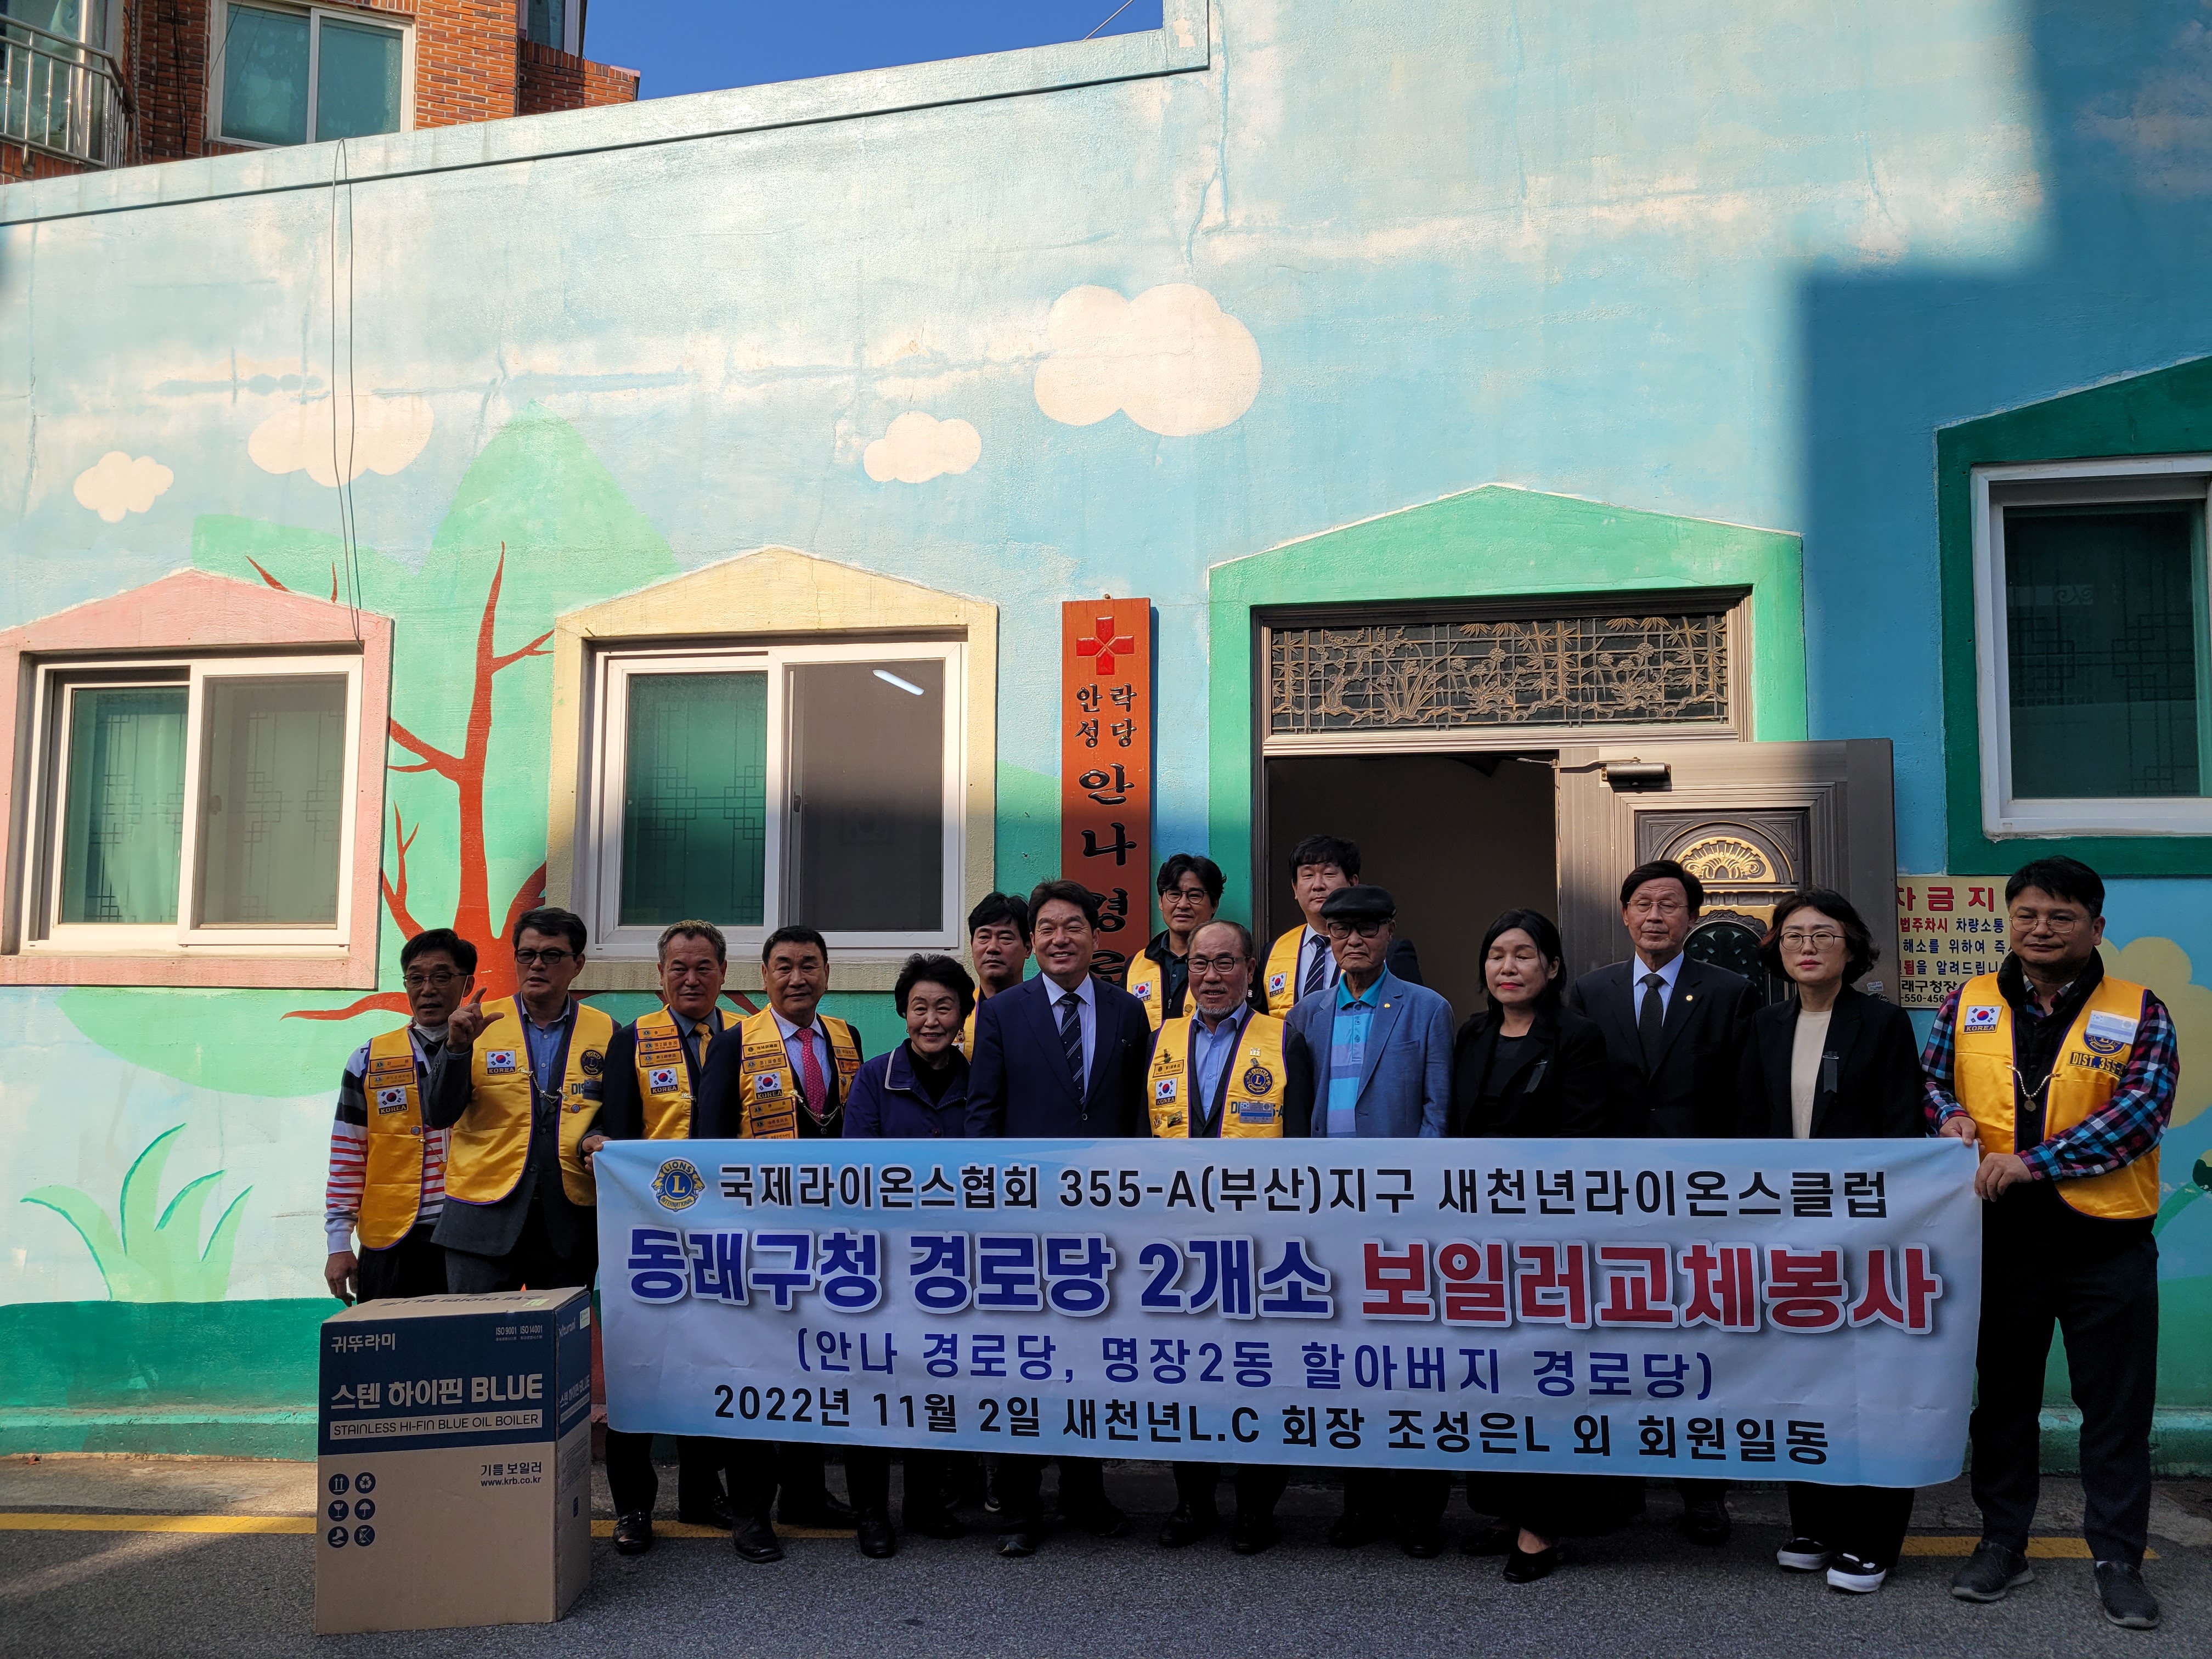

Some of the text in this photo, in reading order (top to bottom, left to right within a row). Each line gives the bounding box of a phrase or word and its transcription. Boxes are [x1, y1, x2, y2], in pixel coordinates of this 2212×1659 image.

[1074, 718, 1137, 748] 성당
[1955, 917, 2004, 934] 차량소통
[1903, 938, 2013, 955] 해소를 위하여 즉
[1936, 960, 2004, 976] 알려드립니
[1270, 988, 1284, 997] KOREA
[2072, 1052, 2096, 1068] DIST.
[1254, 1075, 1262, 1085] L
[757, 1090, 782, 1099] KOREA
[1156, 1097, 1175, 1105] KOREA
[380, 1105, 407, 1114] KOREA
[663, 1161, 692, 1173] LIONS
[672, 1175, 686, 1193] L
[720, 1164, 1887, 1219] 국제라이온스협회 355-A(부산)지구 새천년라이온스클럽
[661, 1197, 694, 1208] INTERNATIONAL
[627, 1228, 1937, 1330] 동래구청 경로당 2개소 보일러교체봉사
[495, 1324, 543, 1336] ISO 9001 ISO 14001
[331, 1333, 396, 1353] 귀뚜라미
[797, 1327, 1712, 1401] (안나 경로당, 명장2동 할아버지 경로당)
[331, 1373, 543, 1409] 스텐 하이핀 BLUE
[334, 1414, 538, 1436] STAINLESS HI-FIN BLUE OIL BOILER
[714, 1384, 1829, 1466] 2022년 11월 2일 새천년L.C 회장 조성은L 외 회원일동
[480, 1461, 542, 1476] 기름 보일러
[481, 1475, 541, 1487] www.krb.co.kr
